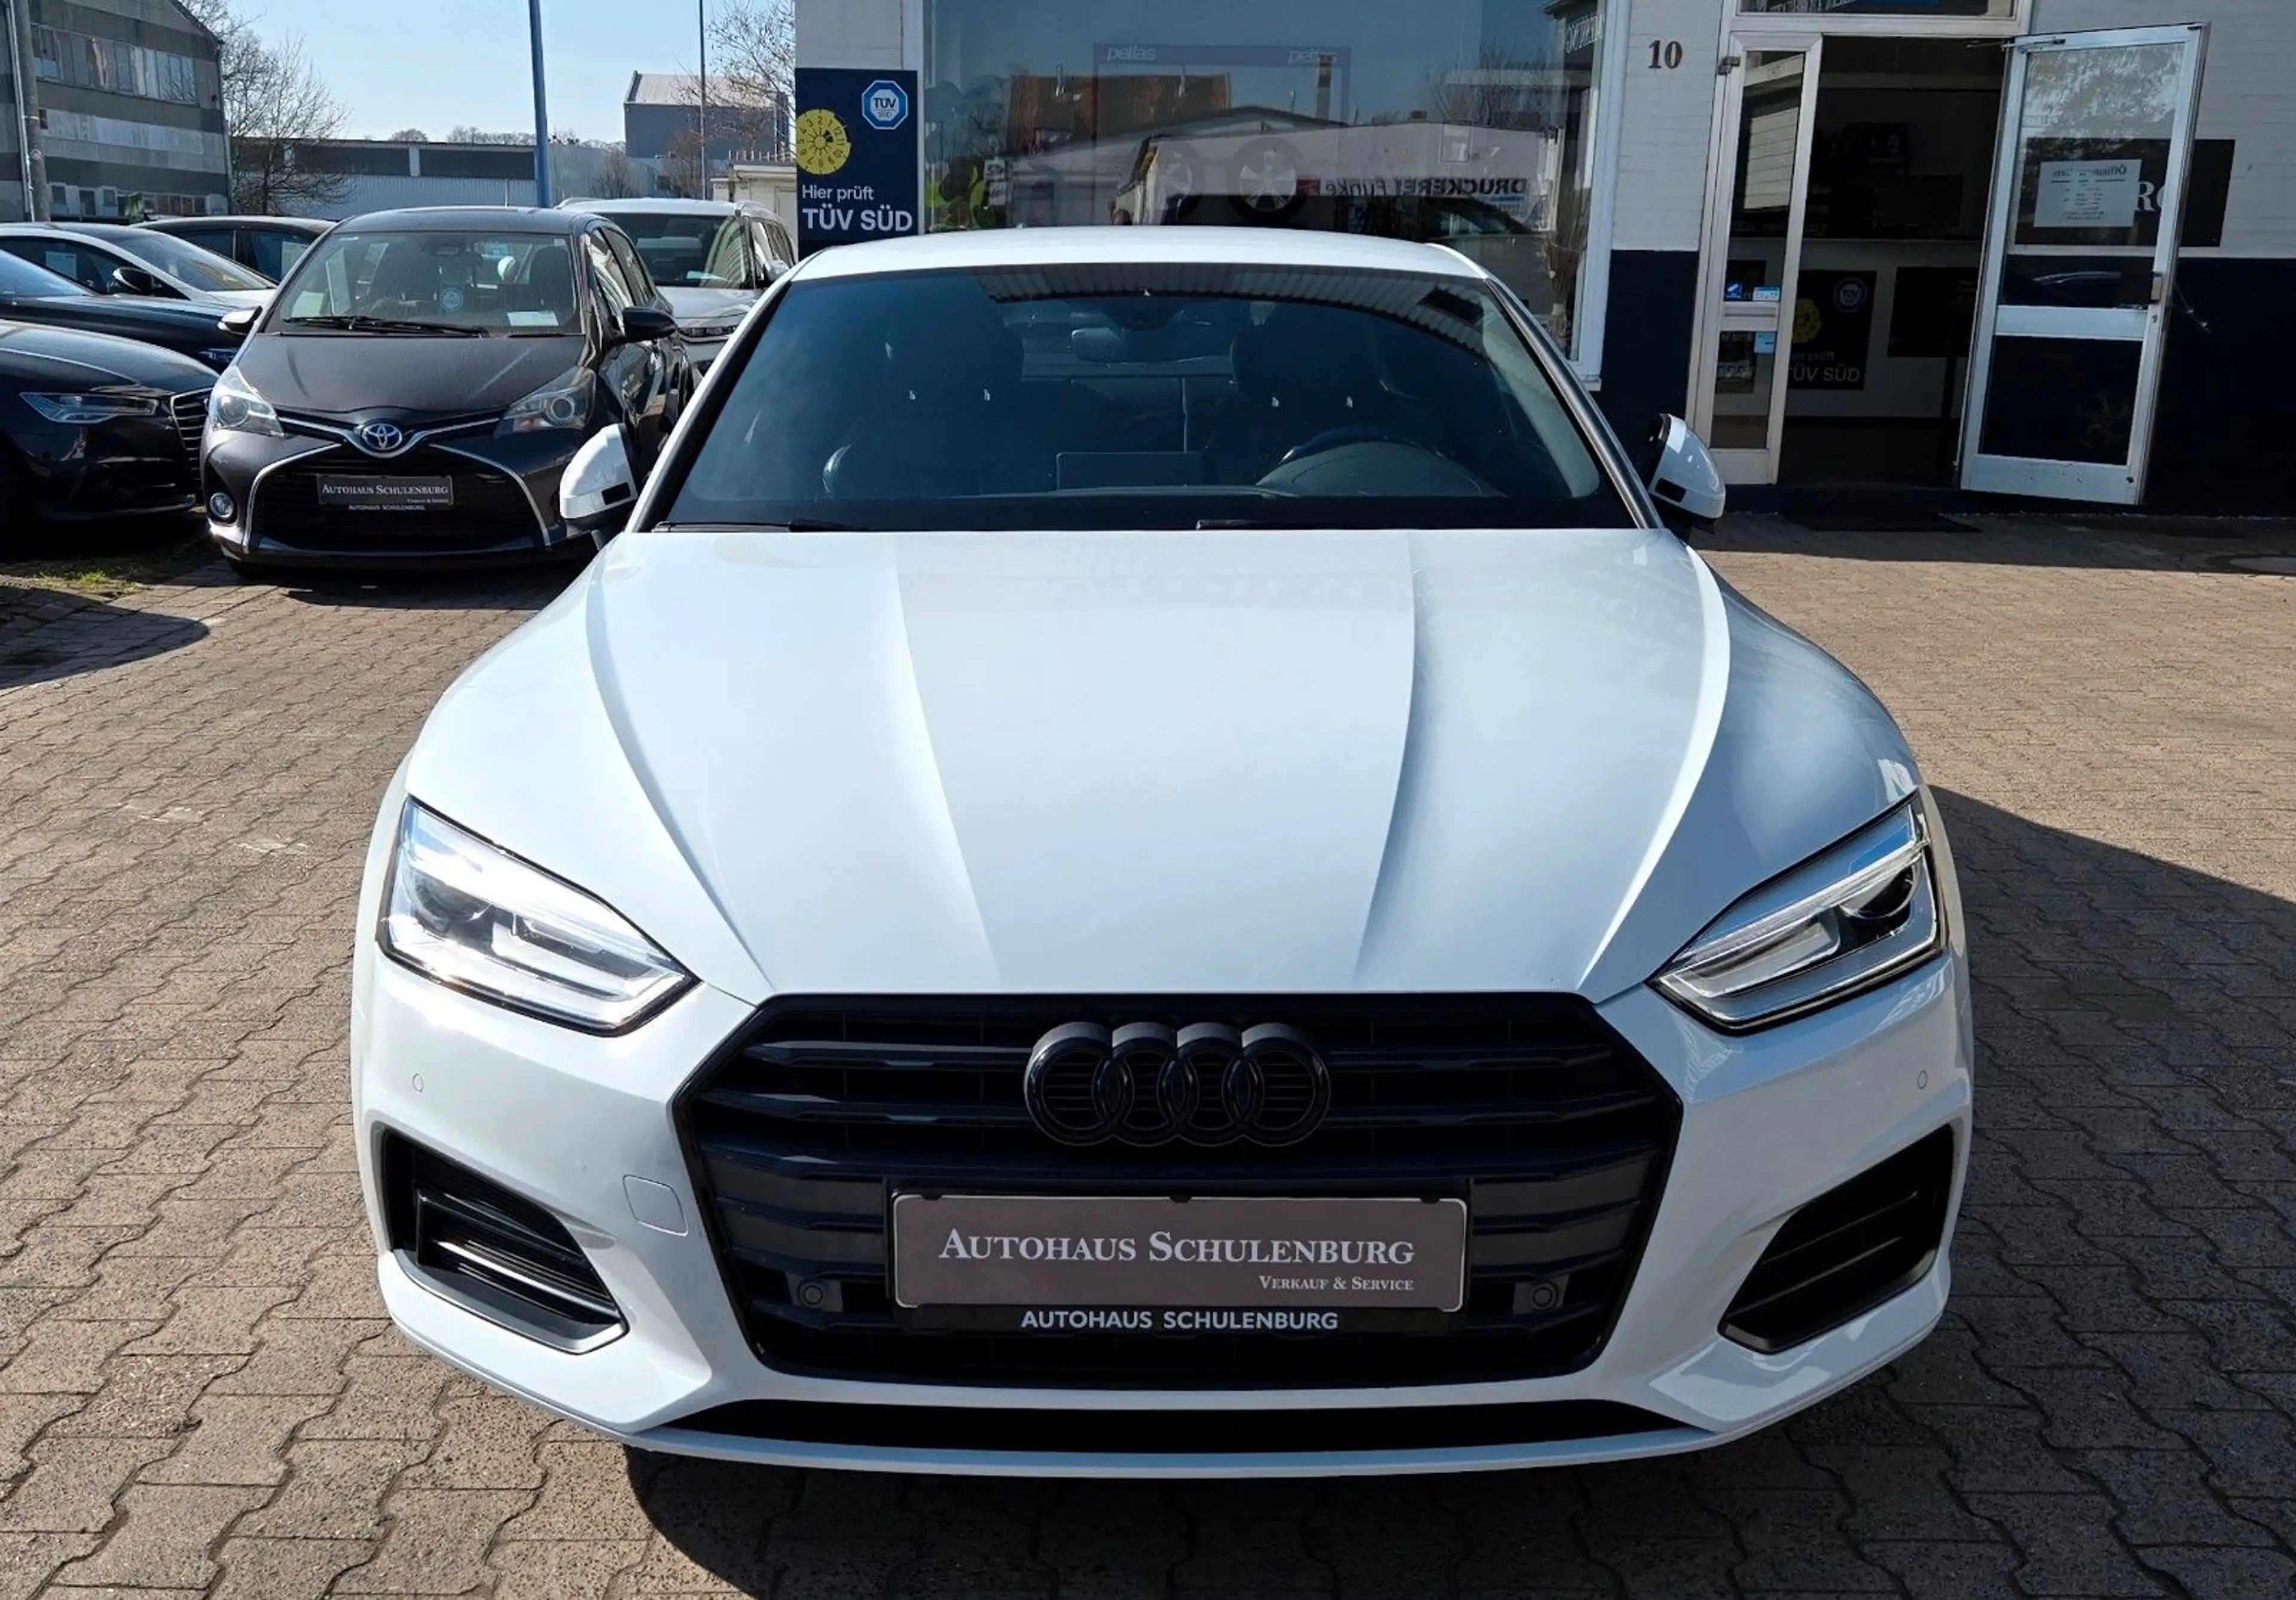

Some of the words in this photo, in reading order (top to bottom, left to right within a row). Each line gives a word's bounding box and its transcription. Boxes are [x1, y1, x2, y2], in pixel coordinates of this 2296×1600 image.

[1648, 40, 1683, 69] 10
[802, 184, 833, 199] Hier
[836, 185, 874, 203] prüft
[802, 202, 854, 231] TÜV
[860, 204, 912, 231] SÜD
[1790, 362, 1819, 381] ÜV
[1823, 362, 1860, 382] SÜD
[938, 1228, 1136, 1261] AUTOHAUS
[1149, 1230, 1415, 1265] SCHULENBURG
[1259, 1275, 1329, 1290] VERKAUF
[1333, 1277, 1347, 1290] &
[1351, 1277, 1415, 1291] SERVICE
[1021, 1310, 1152, 1329] AUTOHAUS
[1164, 1310, 1339, 1330] SCHULENBURG
